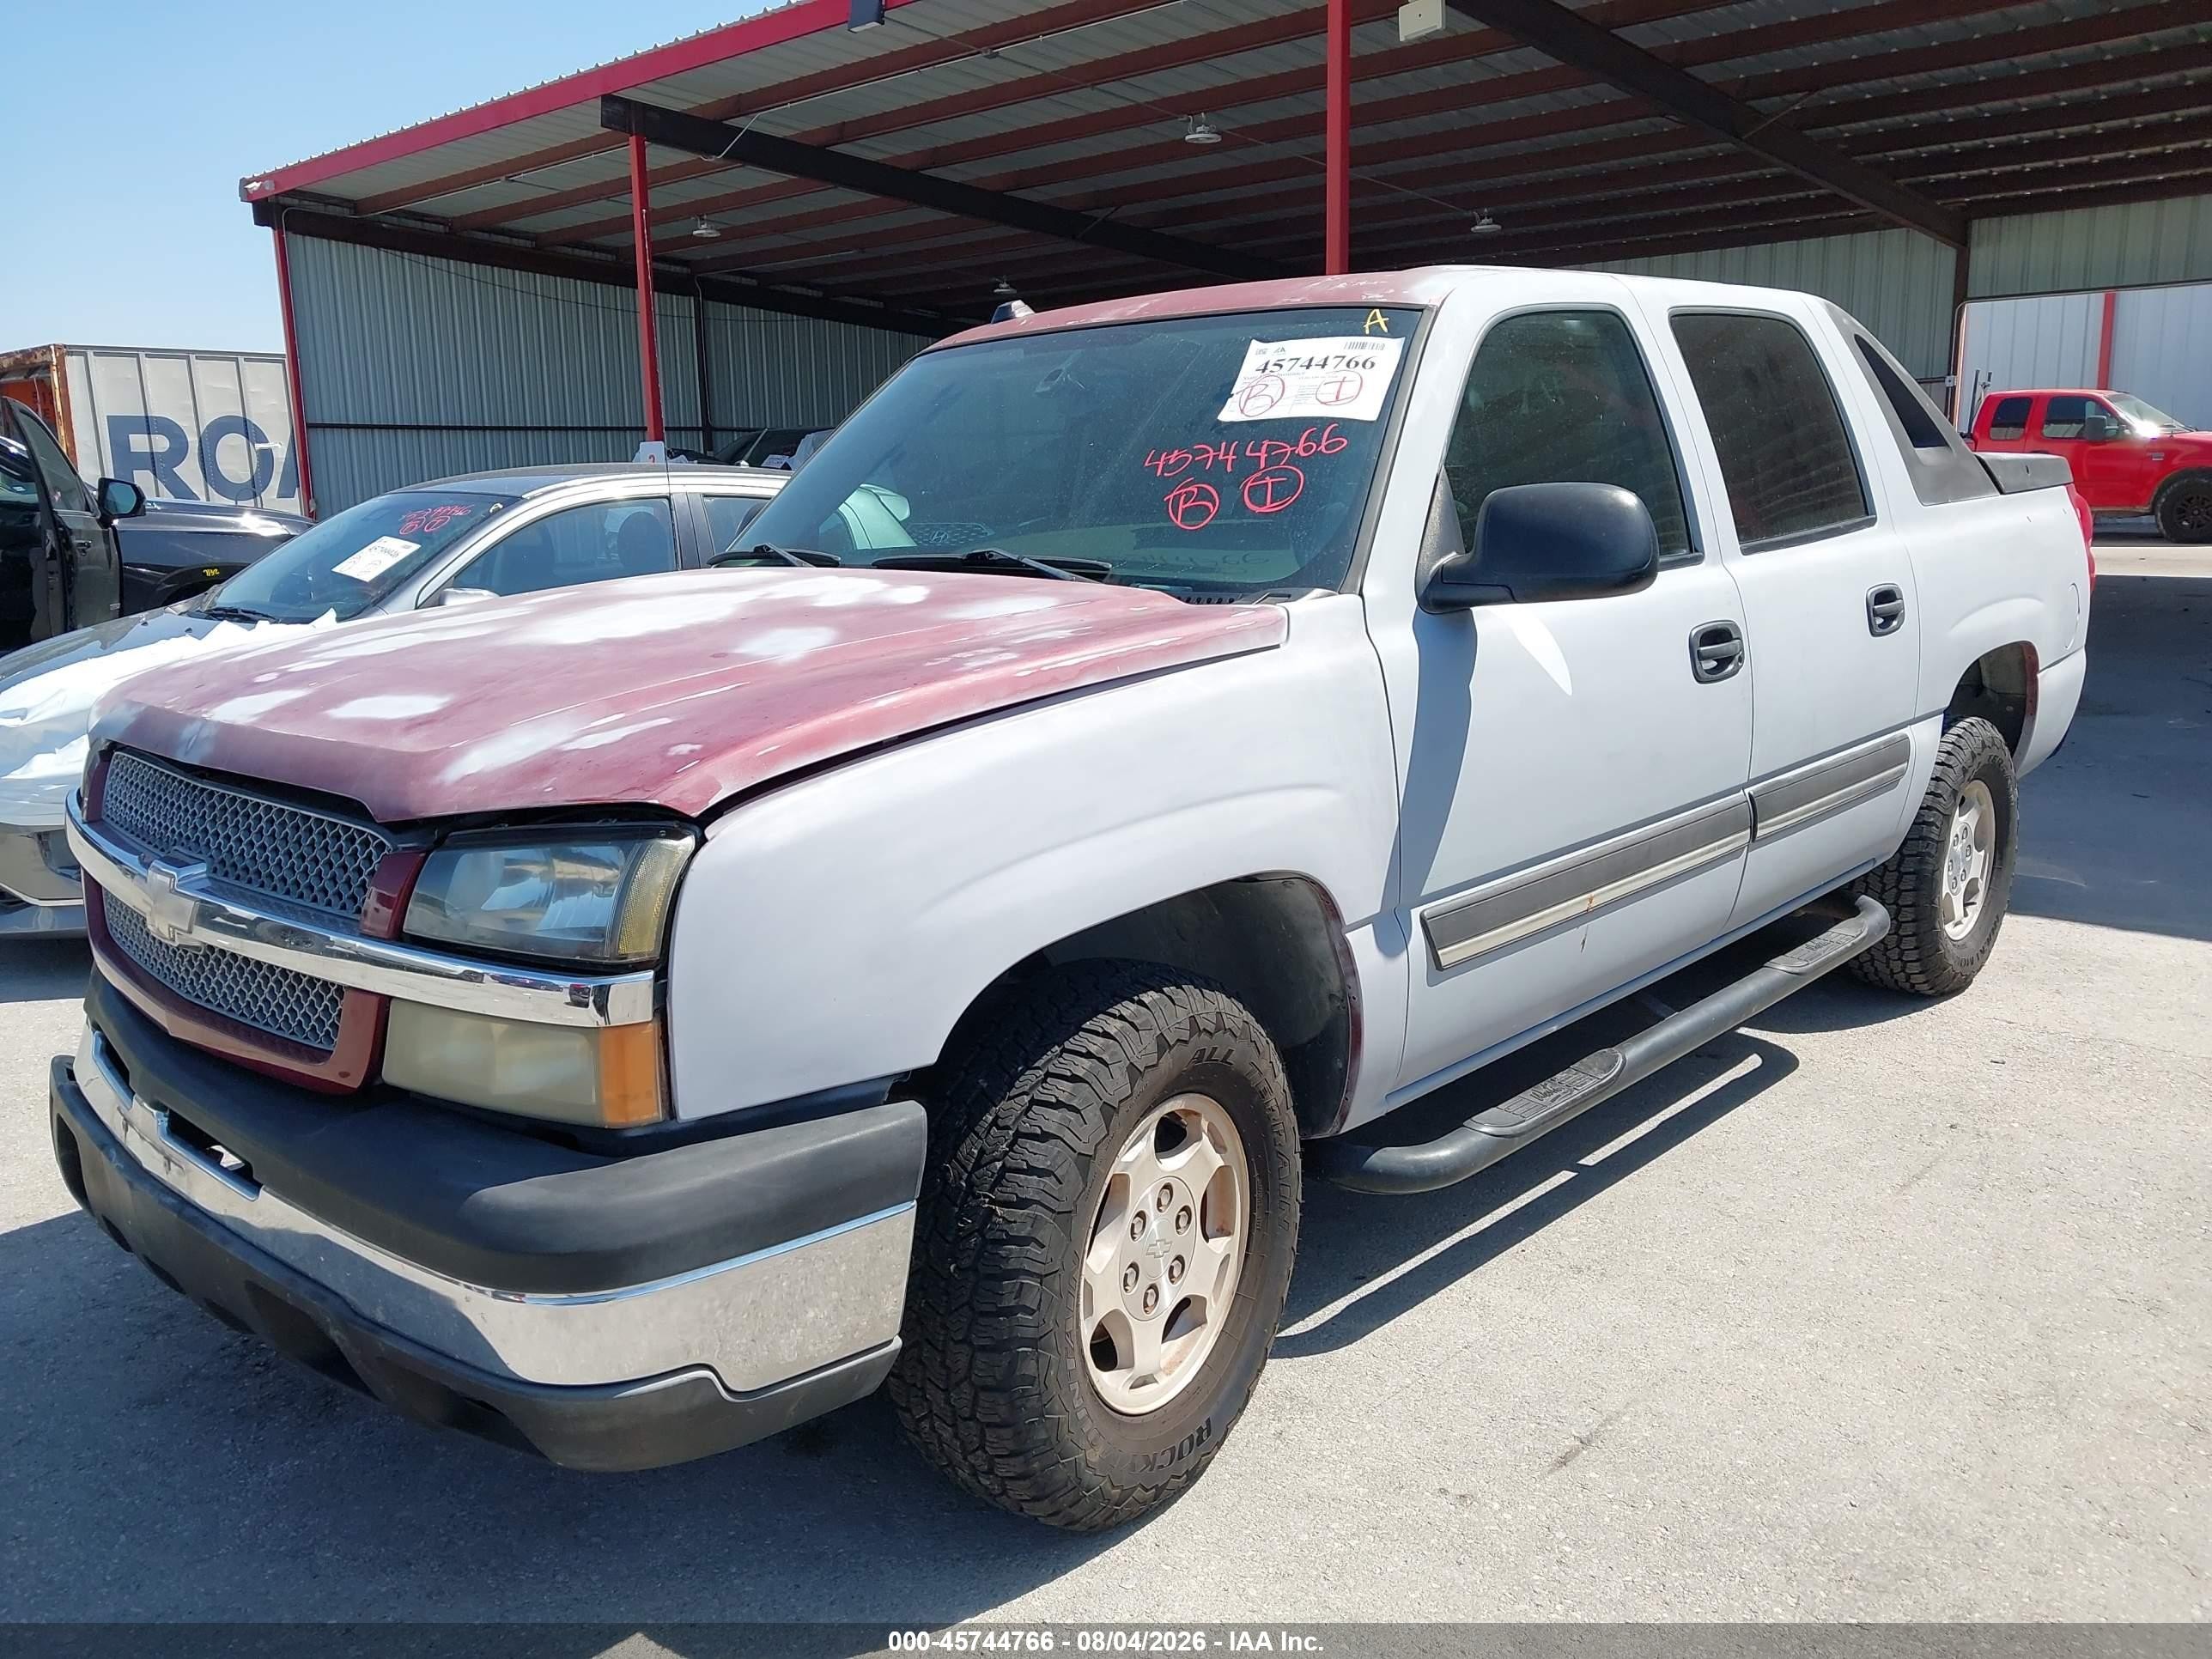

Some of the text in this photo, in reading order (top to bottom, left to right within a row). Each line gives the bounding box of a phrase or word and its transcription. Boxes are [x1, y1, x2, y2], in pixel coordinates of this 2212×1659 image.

[1363, 309, 1389, 335] A
[1255, 355, 1377, 374] 45744766
[106, 415, 298, 501] RO
[1144, 423, 1348, 477] 45744766
[1188, 1046, 1292, 1231] ALL TERRAIN
